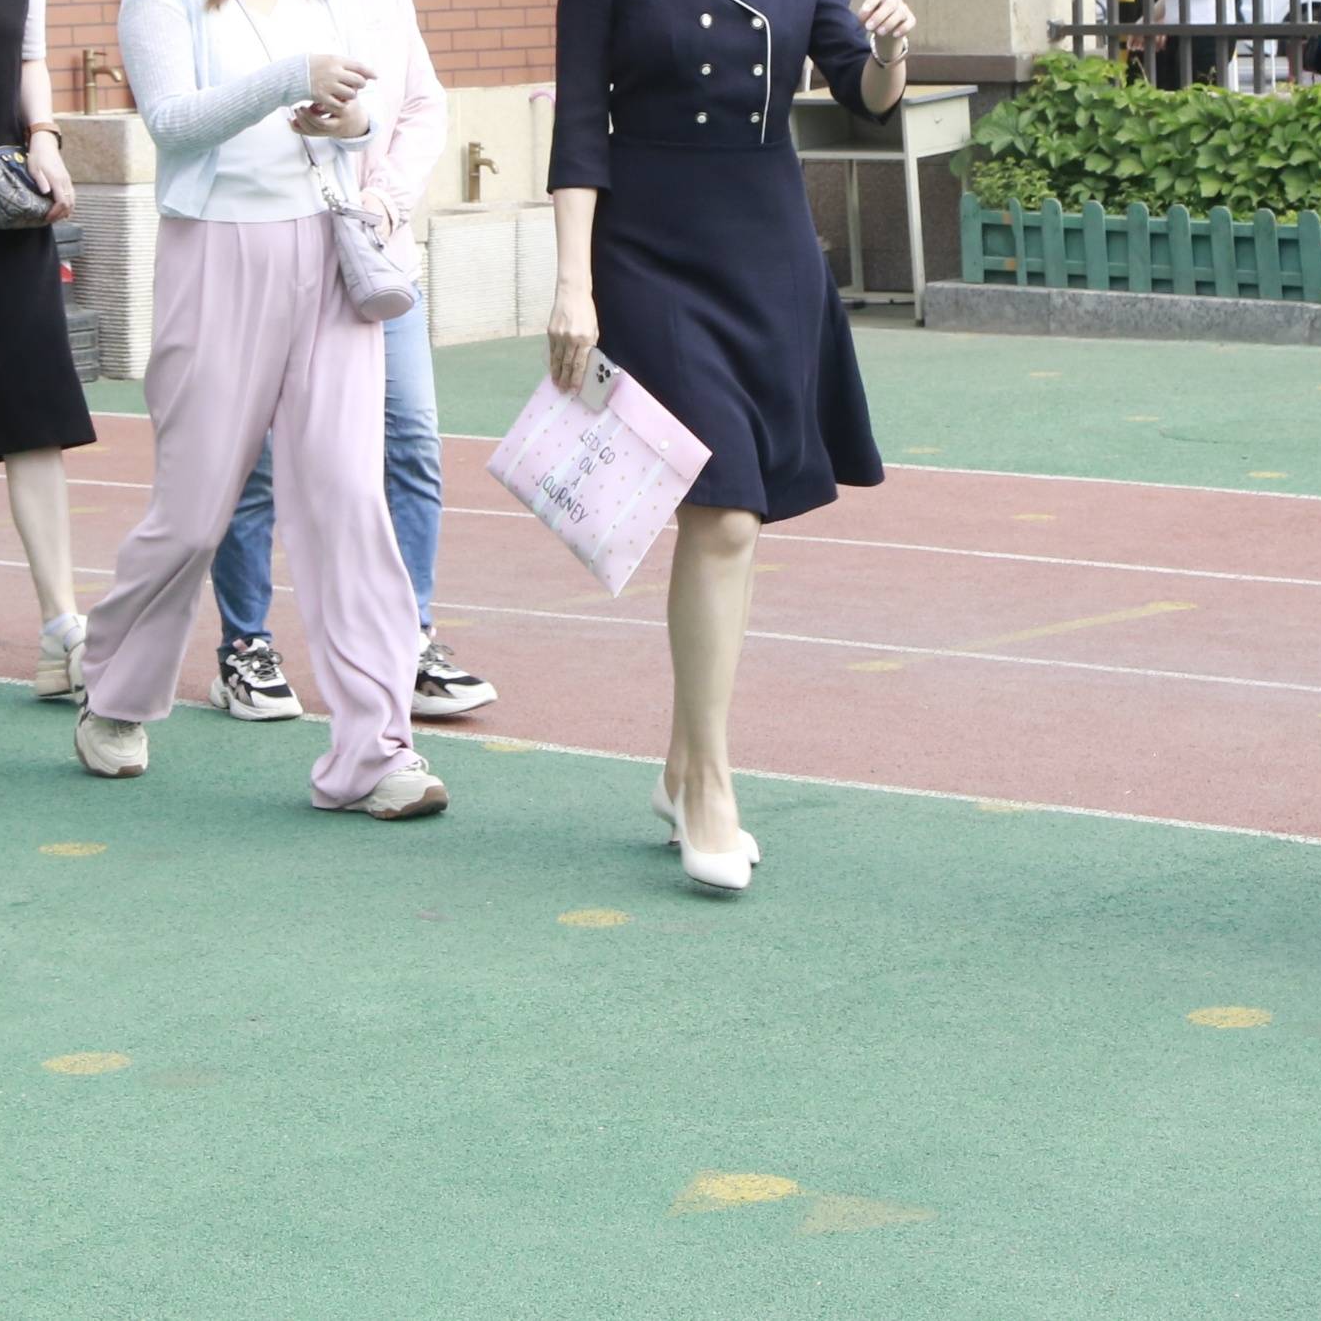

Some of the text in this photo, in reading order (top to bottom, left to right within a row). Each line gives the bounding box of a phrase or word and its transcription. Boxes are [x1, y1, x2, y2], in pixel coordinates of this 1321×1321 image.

[579, 457, 596, 475] ON
[571, 476, 581, 489] A
[535, 472, 588, 524] JOURNEY
